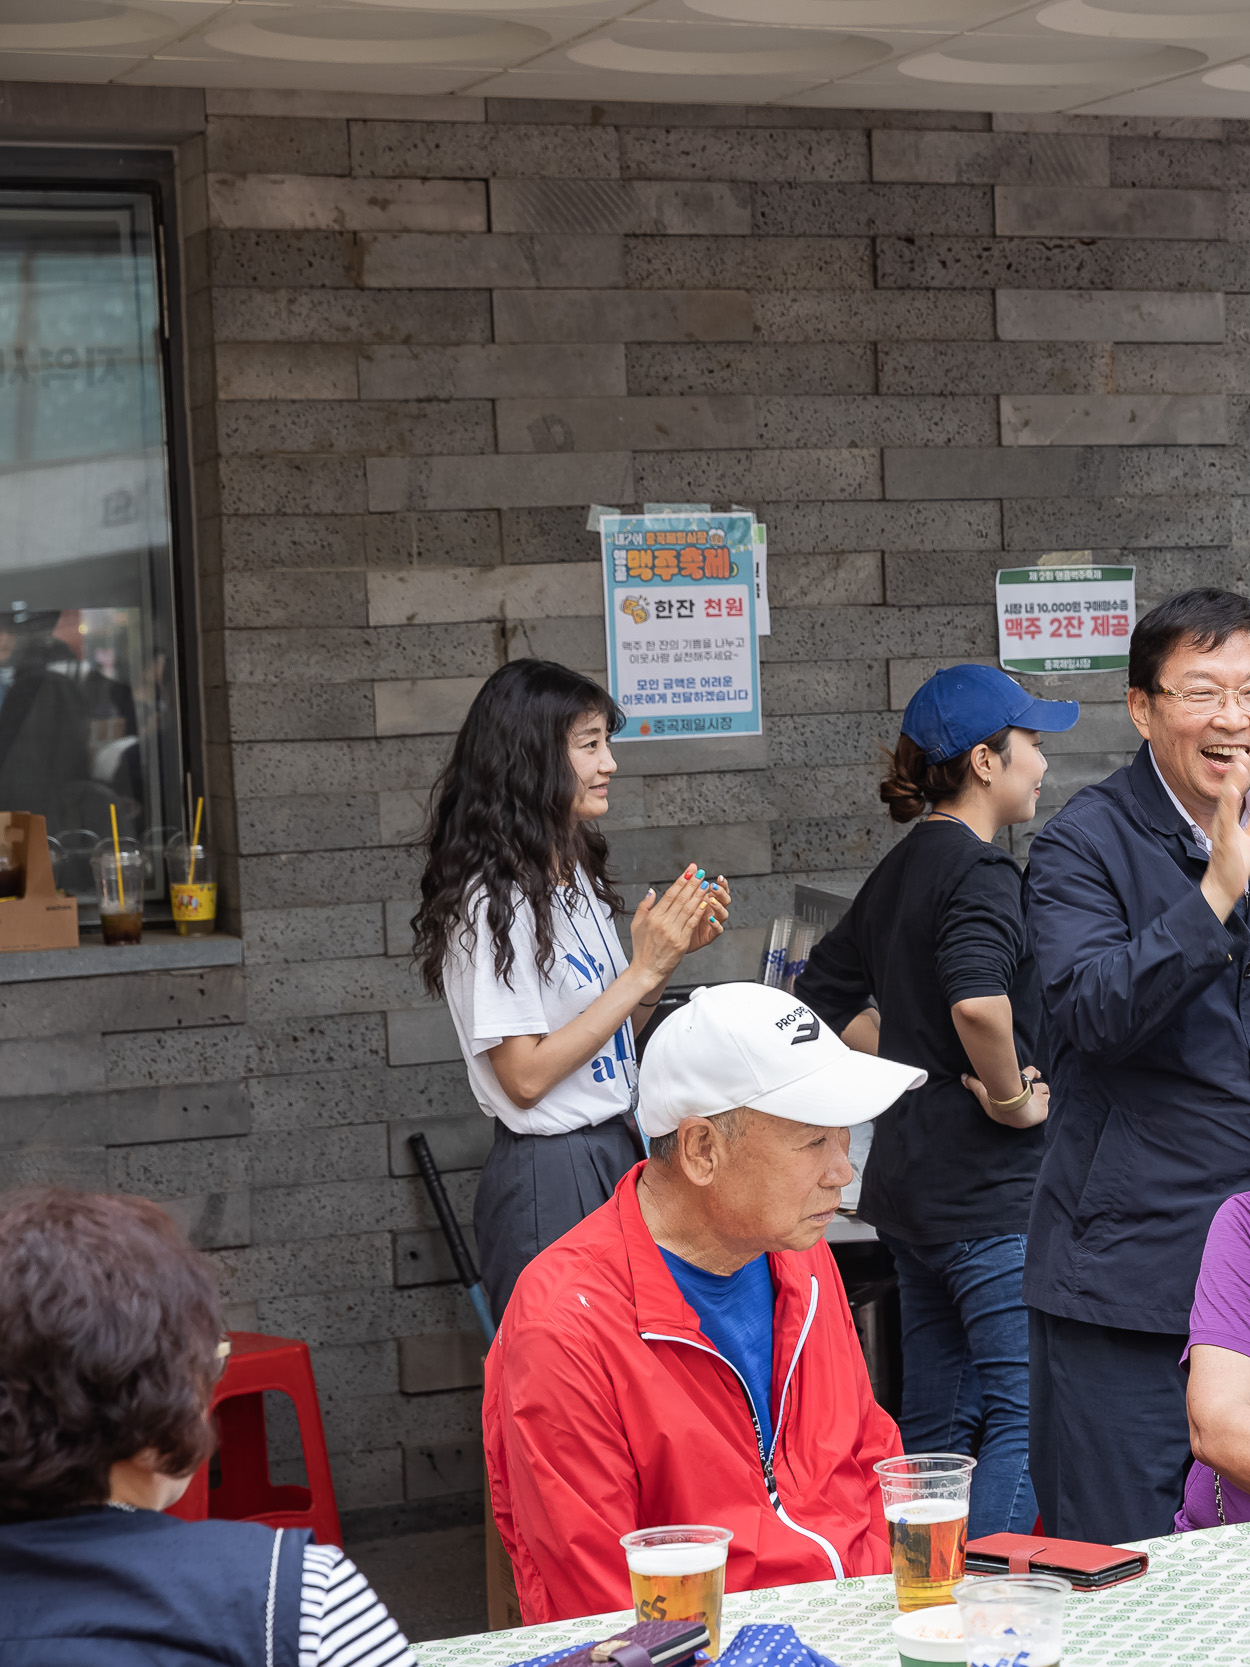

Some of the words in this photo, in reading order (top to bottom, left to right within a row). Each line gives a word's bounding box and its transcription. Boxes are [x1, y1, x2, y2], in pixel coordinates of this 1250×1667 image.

[627, 547, 730, 581] 맥주축제
[654, 599, 695, 619] 한잔
[704, 597, 744, 618] 천원
[1004, 603, 1022, 614] 시장
[1025, 602, 1034, 614] 내
[1005, 617, 1042, 640] 맥주
[1049, 615, 1084, 638] 2잔
[1091, 614, 1129, 637] 제공
[715, 637, 745, 649] 나누고
[637, 679, 659, 691] 모인
[663, 677, 696, 690] 금액은
[700, 676, 732, 688] 어려운
[622, 693, 668, 705] 이웃에게
[671, 689, 748, 704] 전달하겠습니다
[653, 717, 732, 734] 중곡제일시장
